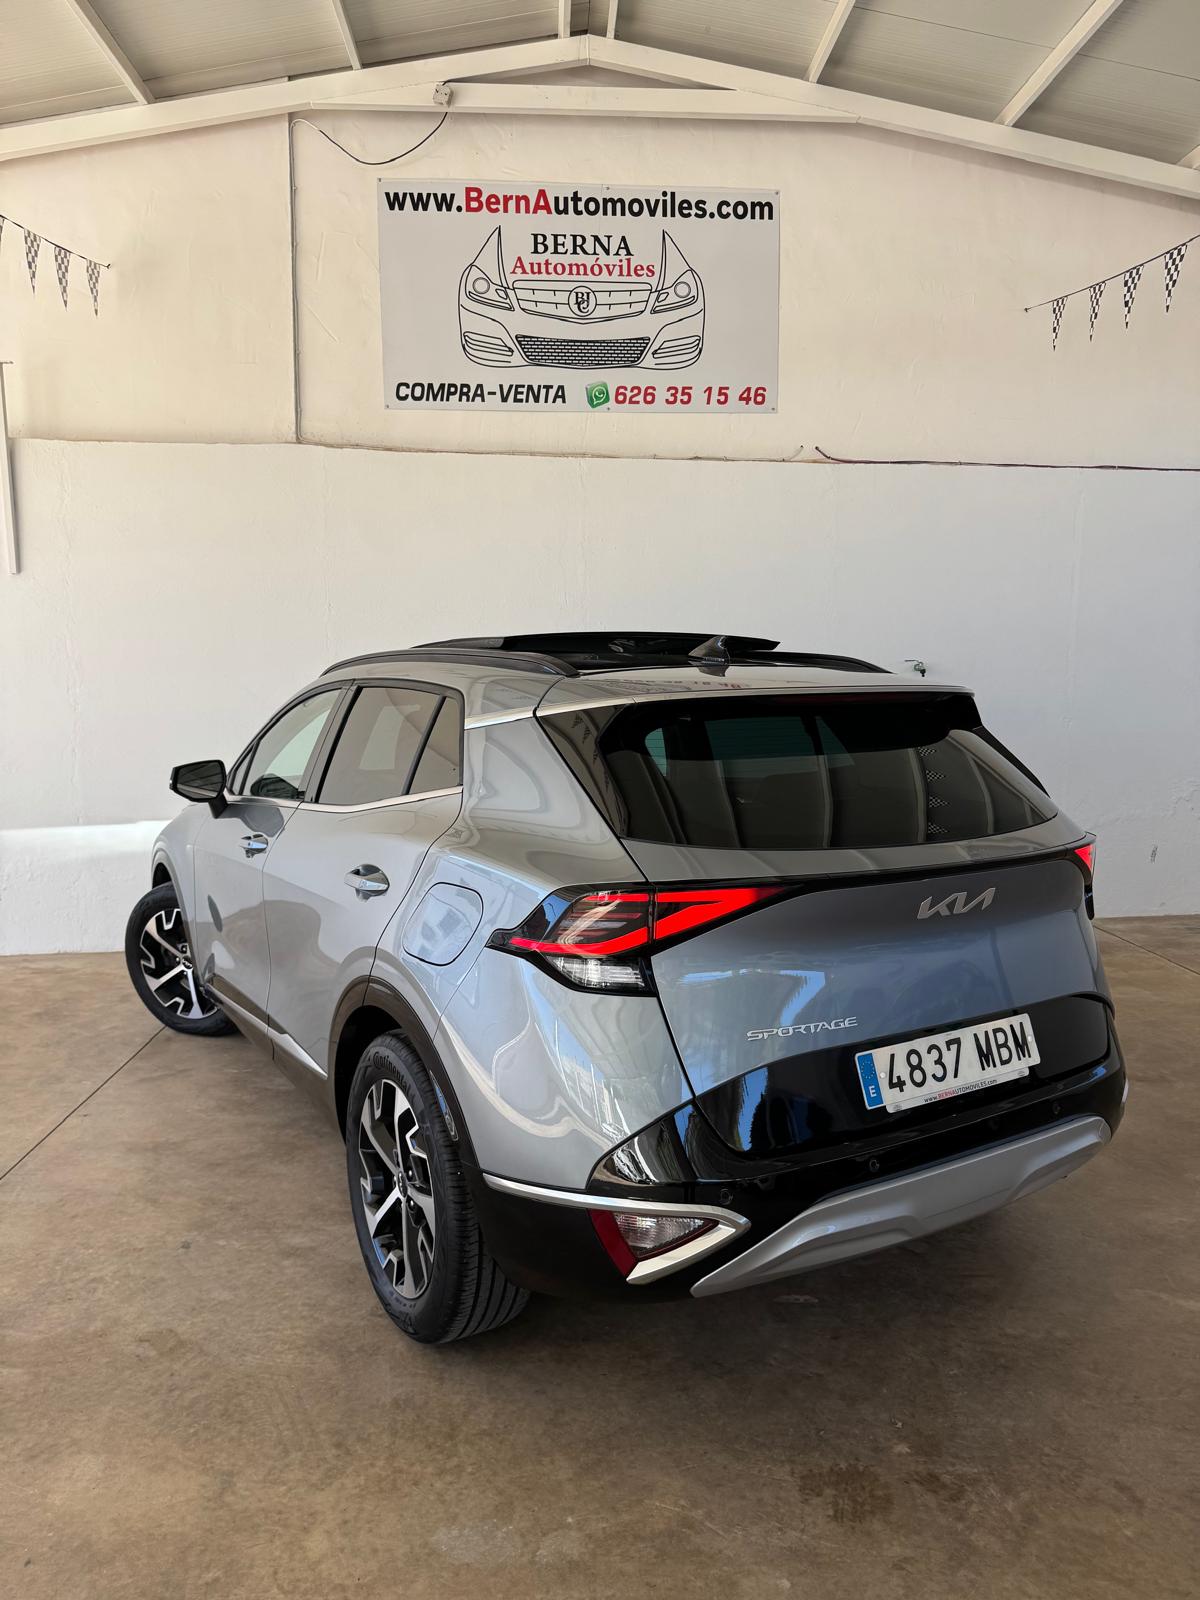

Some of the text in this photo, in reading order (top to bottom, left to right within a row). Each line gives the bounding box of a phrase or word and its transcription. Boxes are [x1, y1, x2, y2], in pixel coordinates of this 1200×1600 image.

[385, 187, 774, 220] www.BernAutomoviles.com
[530, 233, 634, 257] BERNA
[510, 256, 655, 278] Automóviles
[395, 382, 567, 405] COMPRA-VENTA
[614, 385, 767, 406] 626 35 15 46
[917, 887, 996, 920] KIA
[746, 1016, 858, 1041] SPORTAGE
[887, 1021, 1032, 1093] 4837 MBM
[868, 1085, 877, 1098] E
